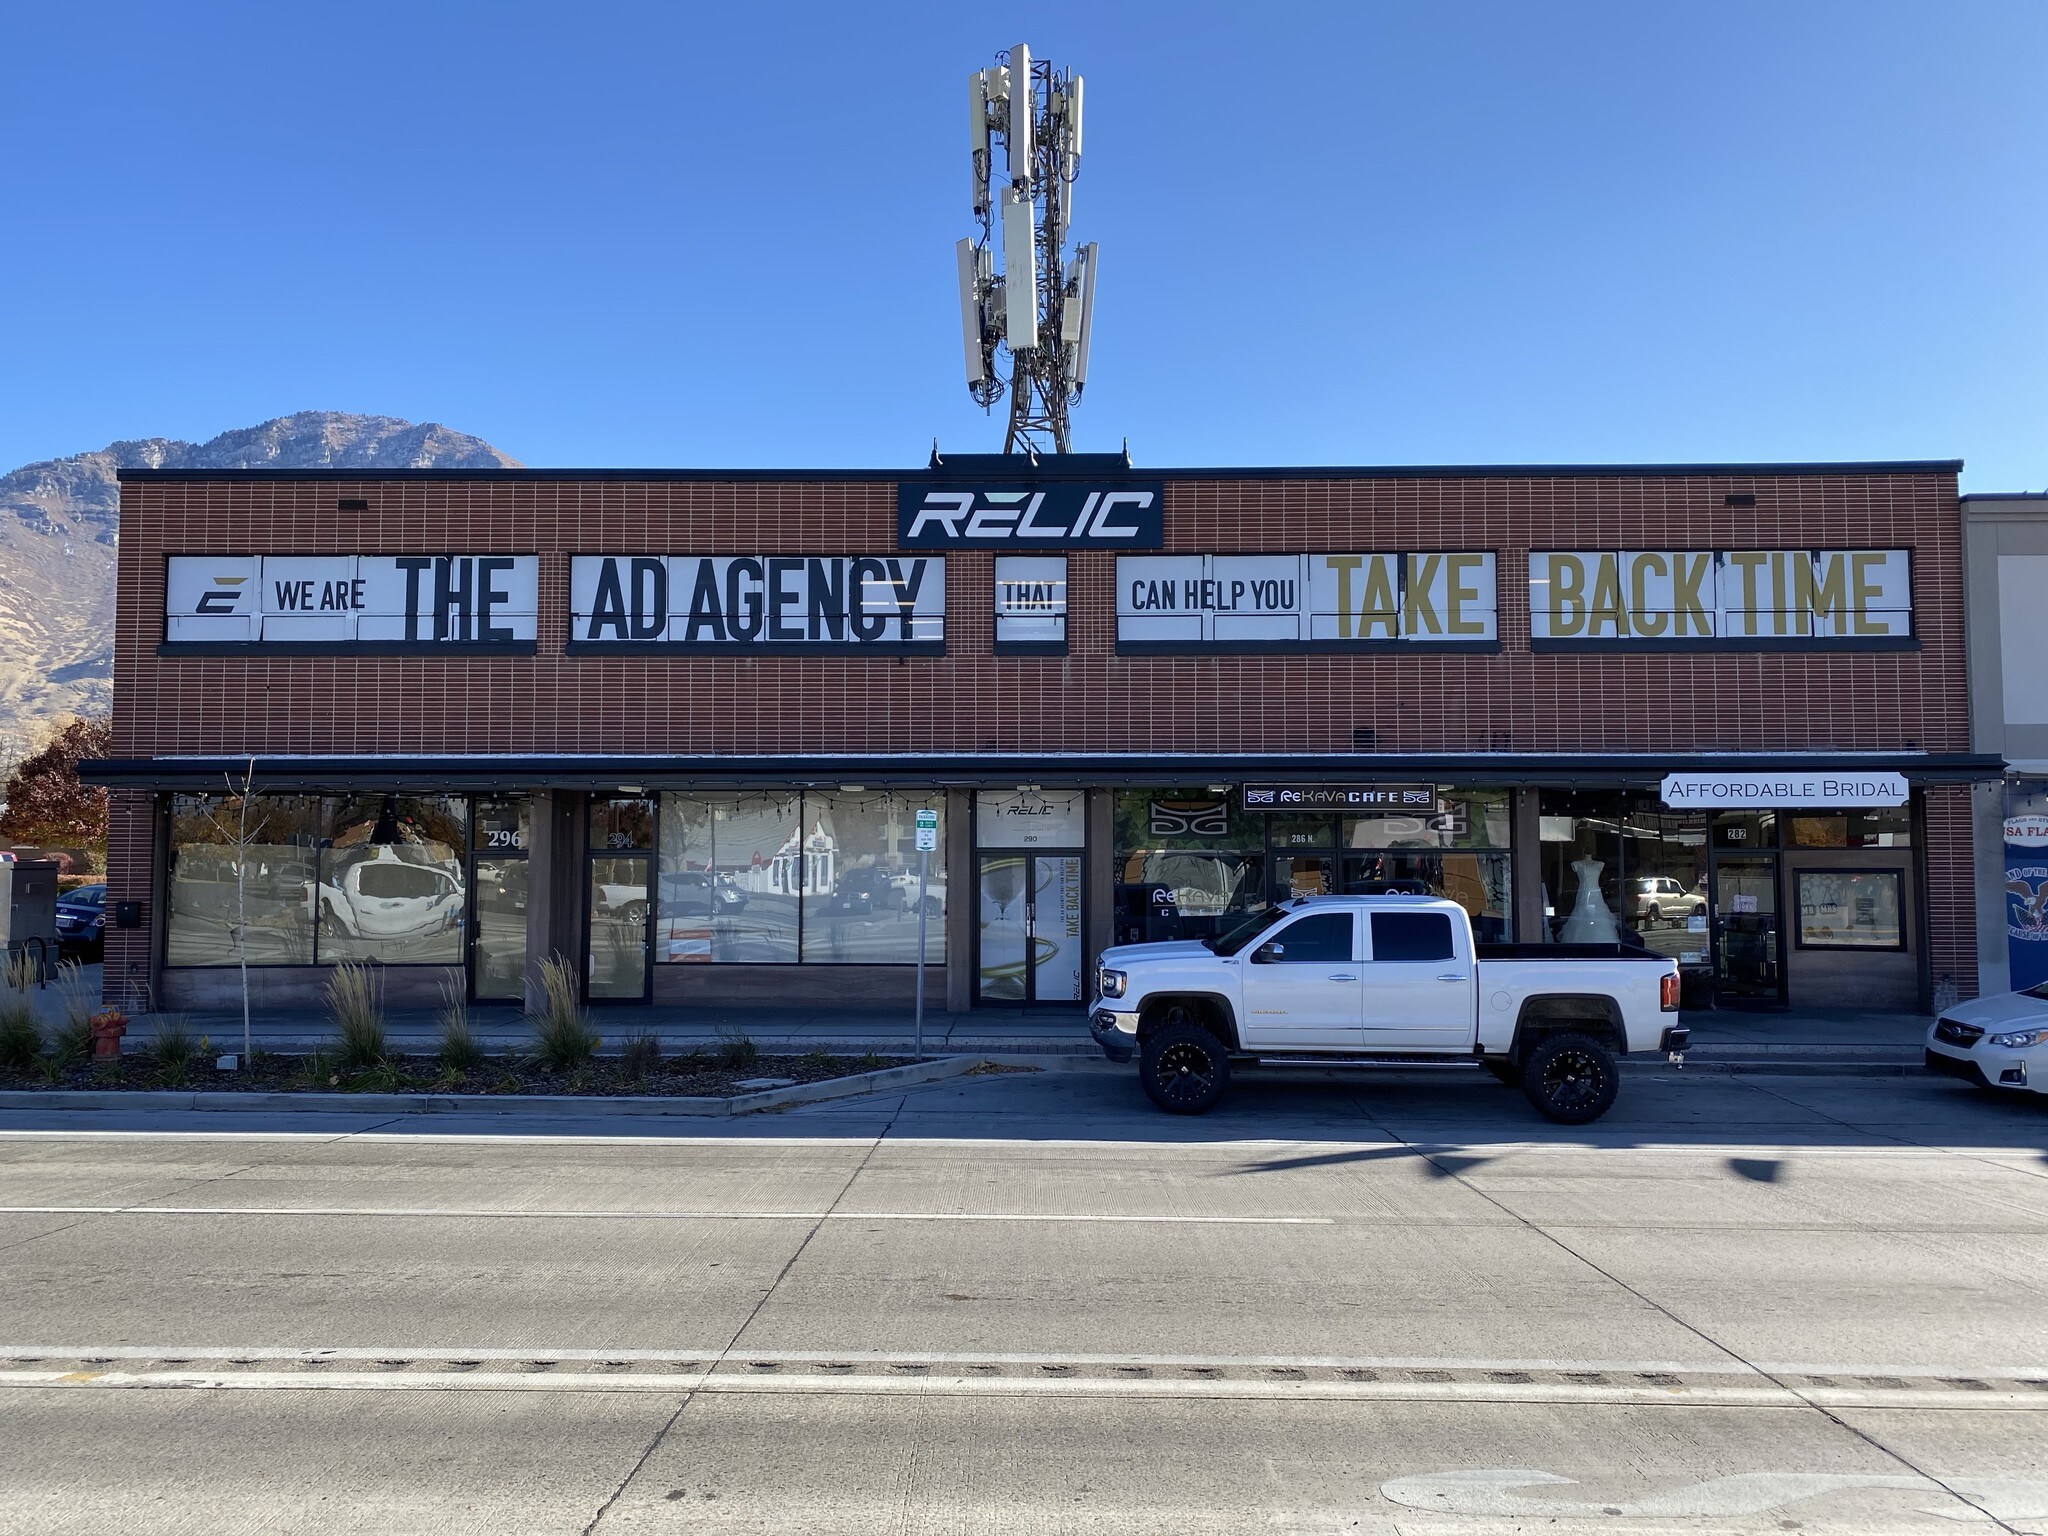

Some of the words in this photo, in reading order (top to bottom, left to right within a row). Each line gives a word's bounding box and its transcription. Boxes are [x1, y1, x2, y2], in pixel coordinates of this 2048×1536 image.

[907, 491, 1154, 537] RELIC
[275, 581, 315, 610] WE
[320, 579, 366, 610] ARE
[396, 558, 515, 641] THE
[587, 558, 667, 639] AD
[685, 558, 927, 641] AGENCY
[1002, 582, 1055, 610] THAT
[1132, 580, 1176, 610] CAN
[1184, 580, 1245, 610] HELP
[1250, 580, 1294, 610] YOU
[1326, 555, 1485, 638] TAKE
[1549, 553, 1712, 636] BACK
[1731, 553, 1890, 636] TIME
[1348, 792, 1398, 802] CAFE
[1007, 805, 1054, 815] RELIC
[488, 830, 521, 847] 296
[607, 830, 634, 848] 294
[1291, 834, 1306, 843] 286
[1728, 829, 1747, 839] 282
[2004, 827, 2023, 836] SA
[1065, 859, 1079, 883] TIME
[2006, 868, 2021, 880] ND
[1066, 886, 1079, 910] BACK
[1066, 914, 1080, 938] TAKE
